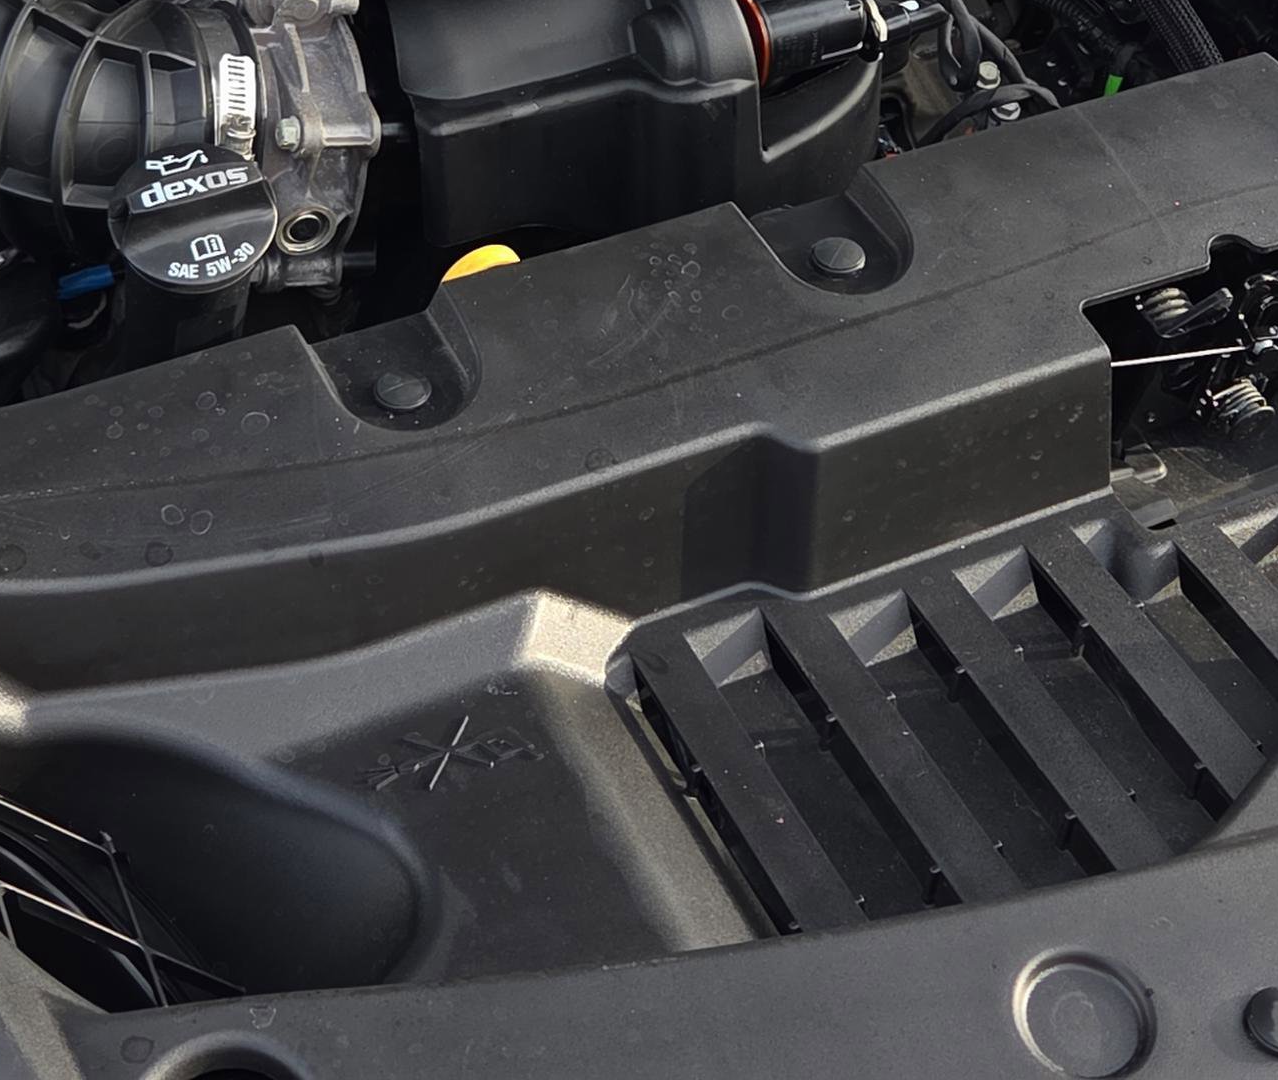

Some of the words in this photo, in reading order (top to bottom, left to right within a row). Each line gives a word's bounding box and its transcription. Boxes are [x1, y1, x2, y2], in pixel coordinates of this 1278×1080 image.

[141, 166, 248, 208] dexos
[168, 262, 199, 278] SAE
[206, 242, 255, 276] 5W-30
